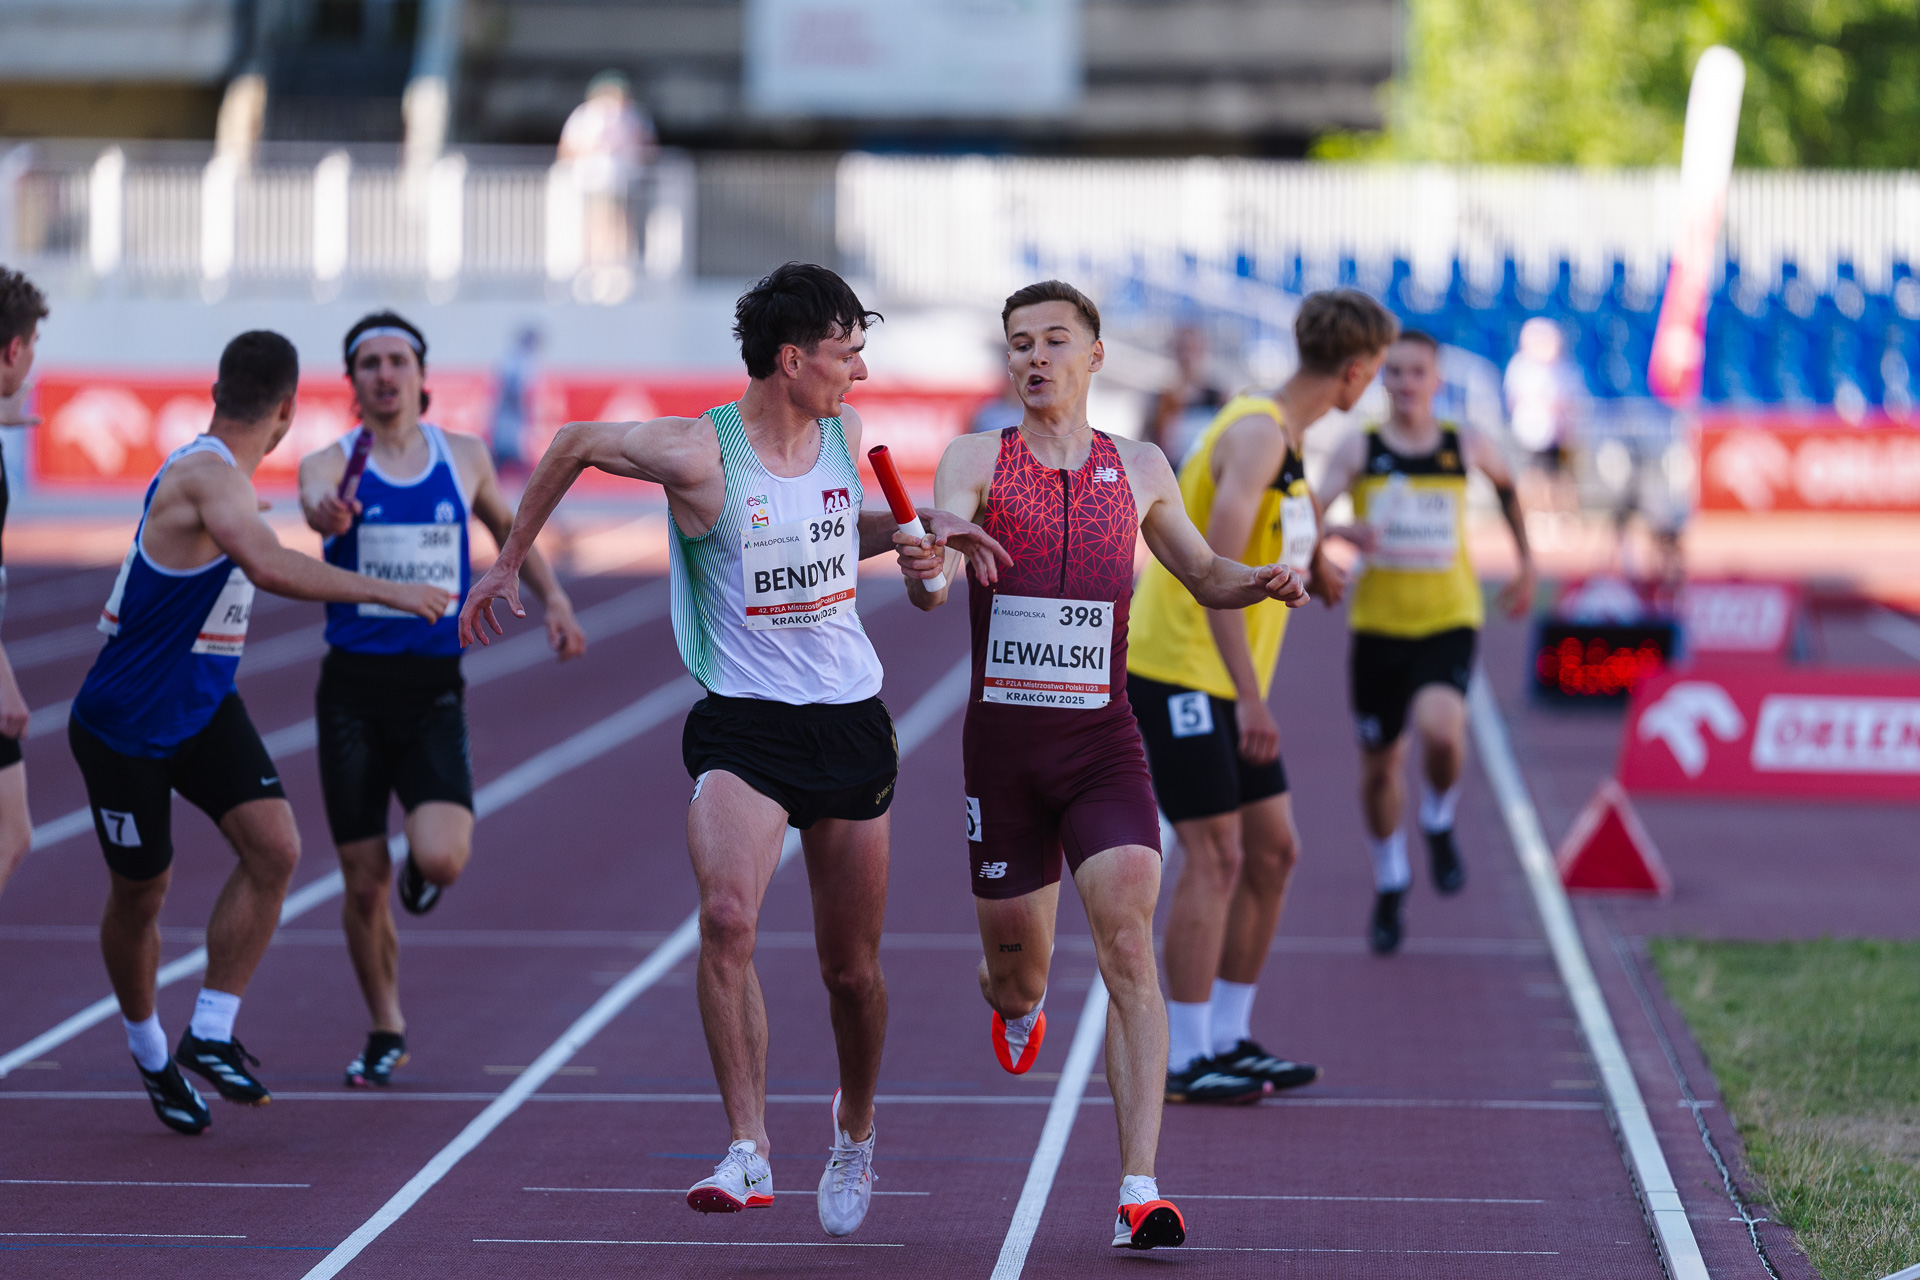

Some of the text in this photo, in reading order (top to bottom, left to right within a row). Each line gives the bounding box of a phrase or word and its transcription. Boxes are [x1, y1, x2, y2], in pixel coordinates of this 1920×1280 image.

[809, 516, 845, 543] 396
[753, 536, 800, 548] MAŁOPOLSKA
[754, 553, 846, 594] BENDYK
[769, 605, 786, 613] PZLA
[836, 591, 848, 600] U23
[772, 613, 821, 626] KRAKÓW
[1001, 605, 1103, 628] MAŁOPOLSKA 398
[991, 639, 1104, 670] LEWALSKI
[1005, 680, 1022, 688] PZLA
[1022, 681, 1064, 690] Mistrzostwa
[1006, 692, 1085, 705] KRAKÓW 2025
[1181, 699, 1201, 729] 5
[107, 814, 125, 842] 7
[999, 943, 1023, 952] run
